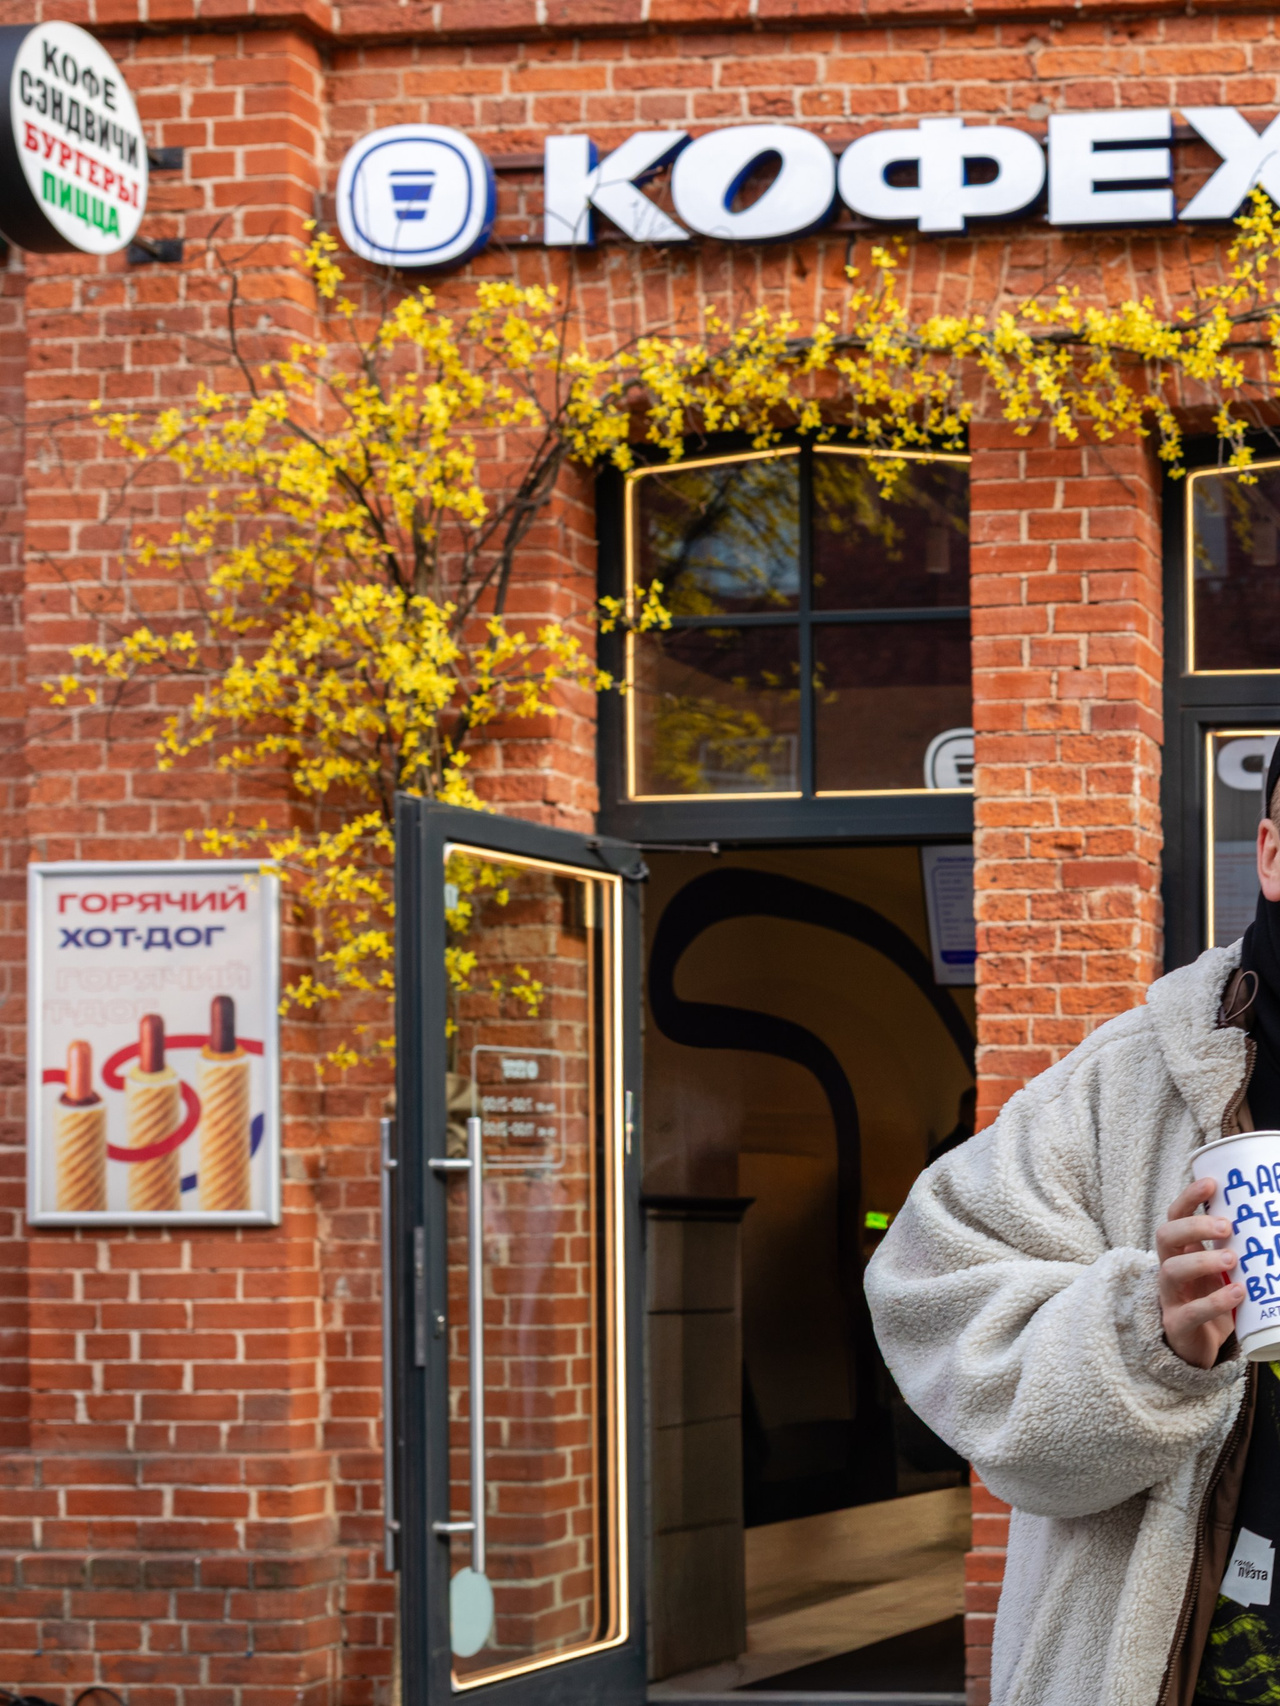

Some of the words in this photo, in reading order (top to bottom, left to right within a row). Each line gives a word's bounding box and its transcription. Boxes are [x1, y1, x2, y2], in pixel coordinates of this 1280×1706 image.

[42, 39, 117, 111] КОФЕ
[20, 70, 139, 169] СЭНДВИЧИ
[24, 120, 139, 209] БУРГЕРЫ
[42, 169, 120, 239] ПИЦЦА
[58, 885, 247, 914] ГОРЯЧИЙ
[59, 926, 225, 950] ХОТ-ДОГ
